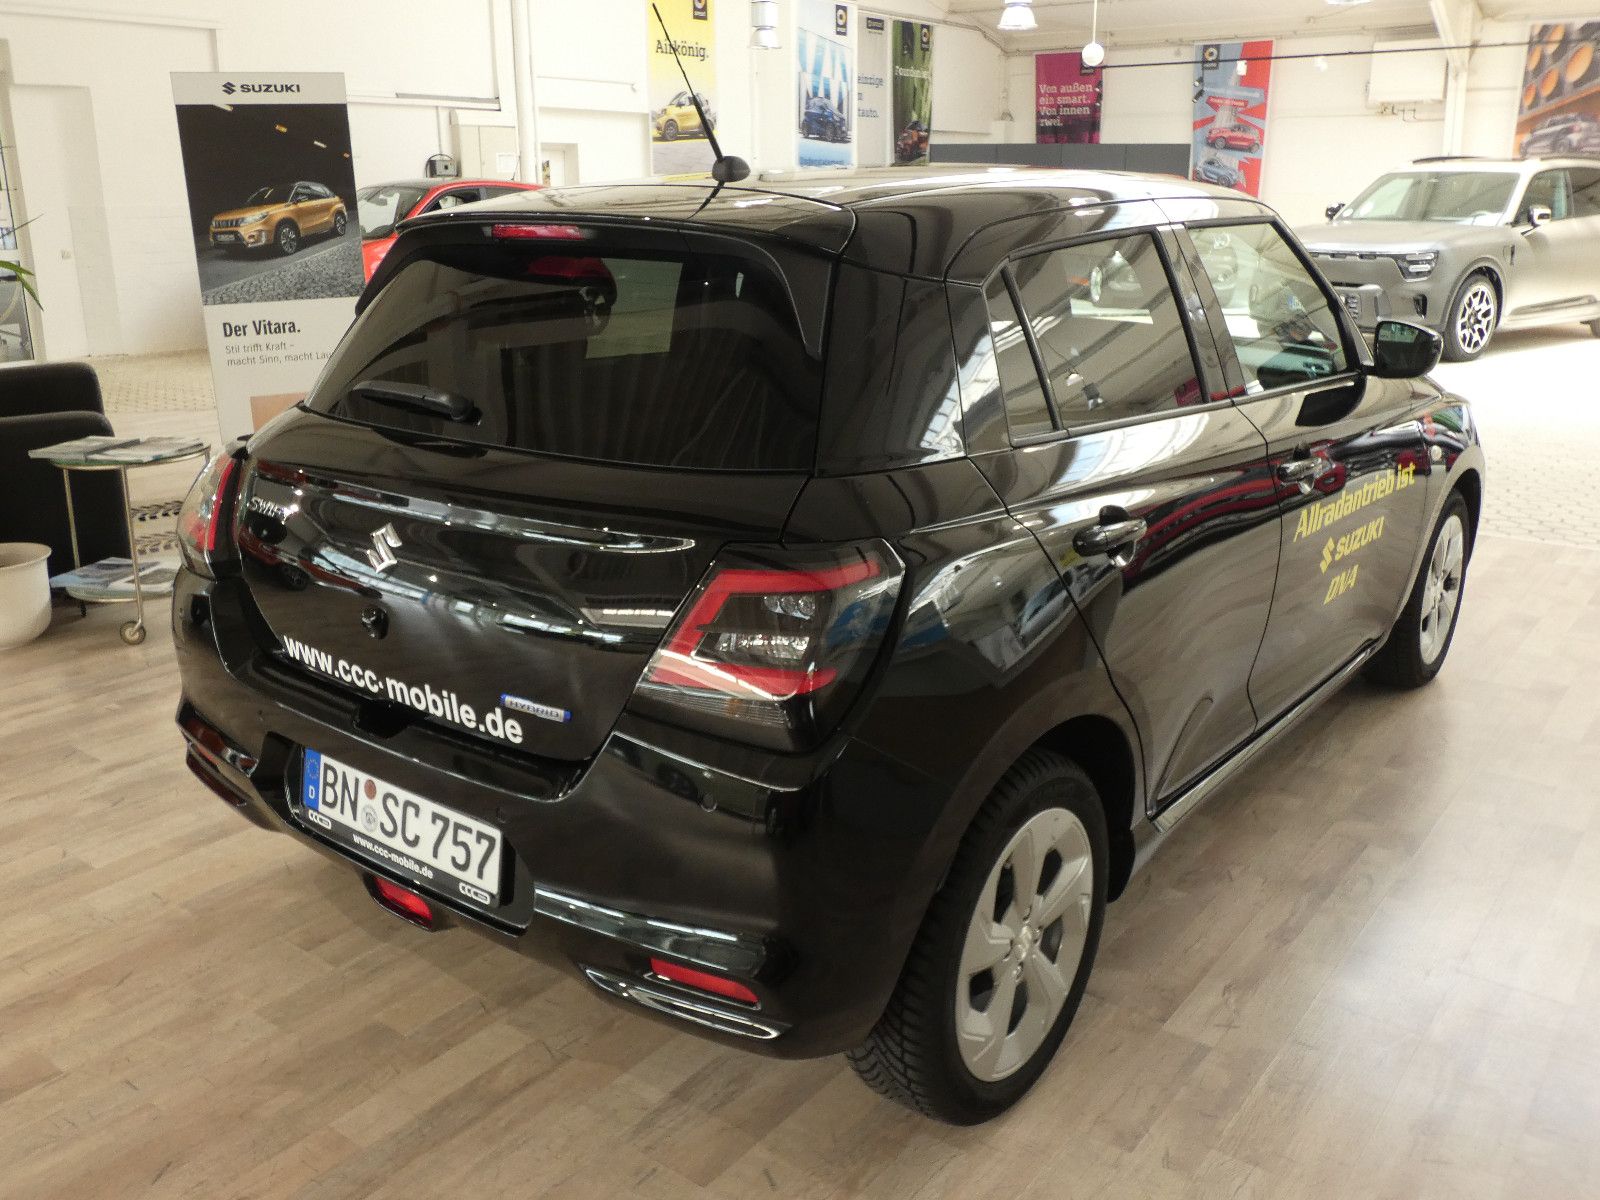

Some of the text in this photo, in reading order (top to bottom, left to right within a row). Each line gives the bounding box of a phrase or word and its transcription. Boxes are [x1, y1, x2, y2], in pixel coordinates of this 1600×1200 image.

[240, 83, 301, 93] SUZUKI
[1039, 82, 1094, 93] Von außen
[1039, 94, 1091, 104] ein smart.
[1060, 105, 1090, 115] innen
[222, 319, 301, 338] Der Vitara.
[225, 344, 240, 354] Stil
[243, 342, 263, 353] trifft
[265, 341, 286, 351] Kraft
[227, 351, 333, 367] macht Sinn, macht Lau
[1293, 461, 1416, 543] Allradantrieb ist
[1335, 515, 1385, 561] SUZUKI
[308, 785, 315, 799] D
[321, 762, 497, 880] BN SC 757
[352, 833, 434, 880] www.ccc-mobile.de
